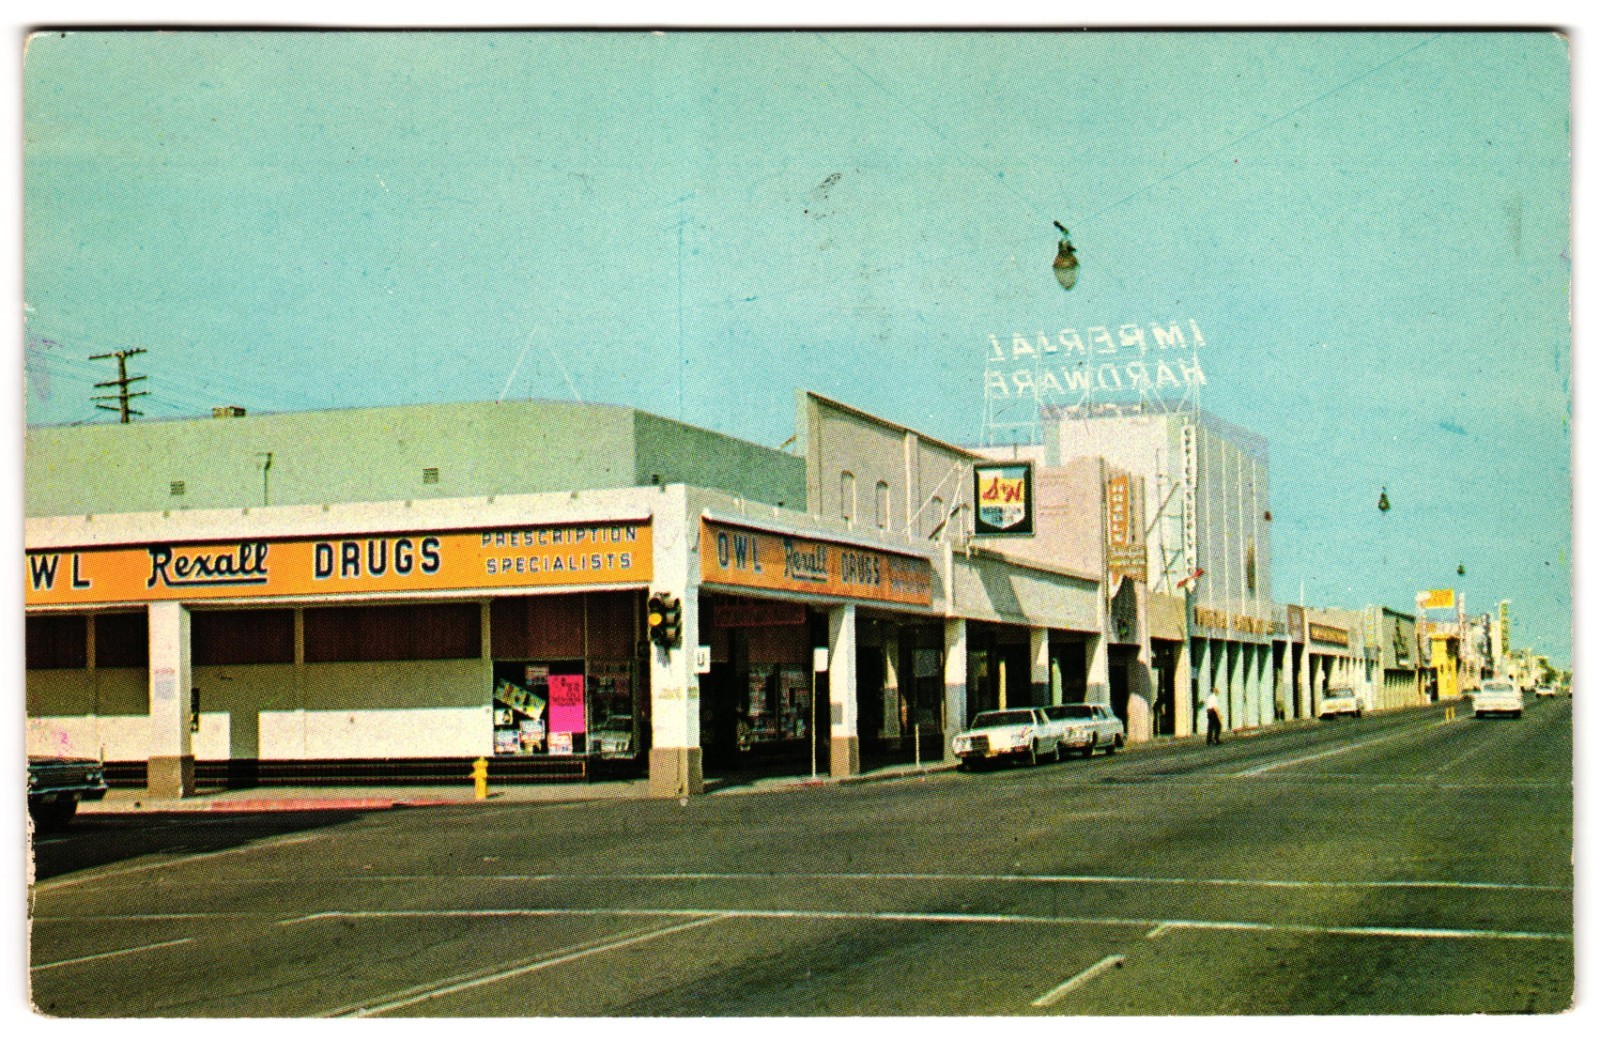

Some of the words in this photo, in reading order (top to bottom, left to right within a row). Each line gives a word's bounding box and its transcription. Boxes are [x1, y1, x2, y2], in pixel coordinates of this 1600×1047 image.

[481, 526, 637, 548] PRESCRIPTION
[147, 541, 267, 588] Rexall
[313, 536, 441, 579] DRUGS
[486, 552, 632, 574] SPECIALISTS
[717, 531, 763, 573] OWL
[783, 537, 828, 583] Rexall
[841, 551, 881, 587] DRUGS
